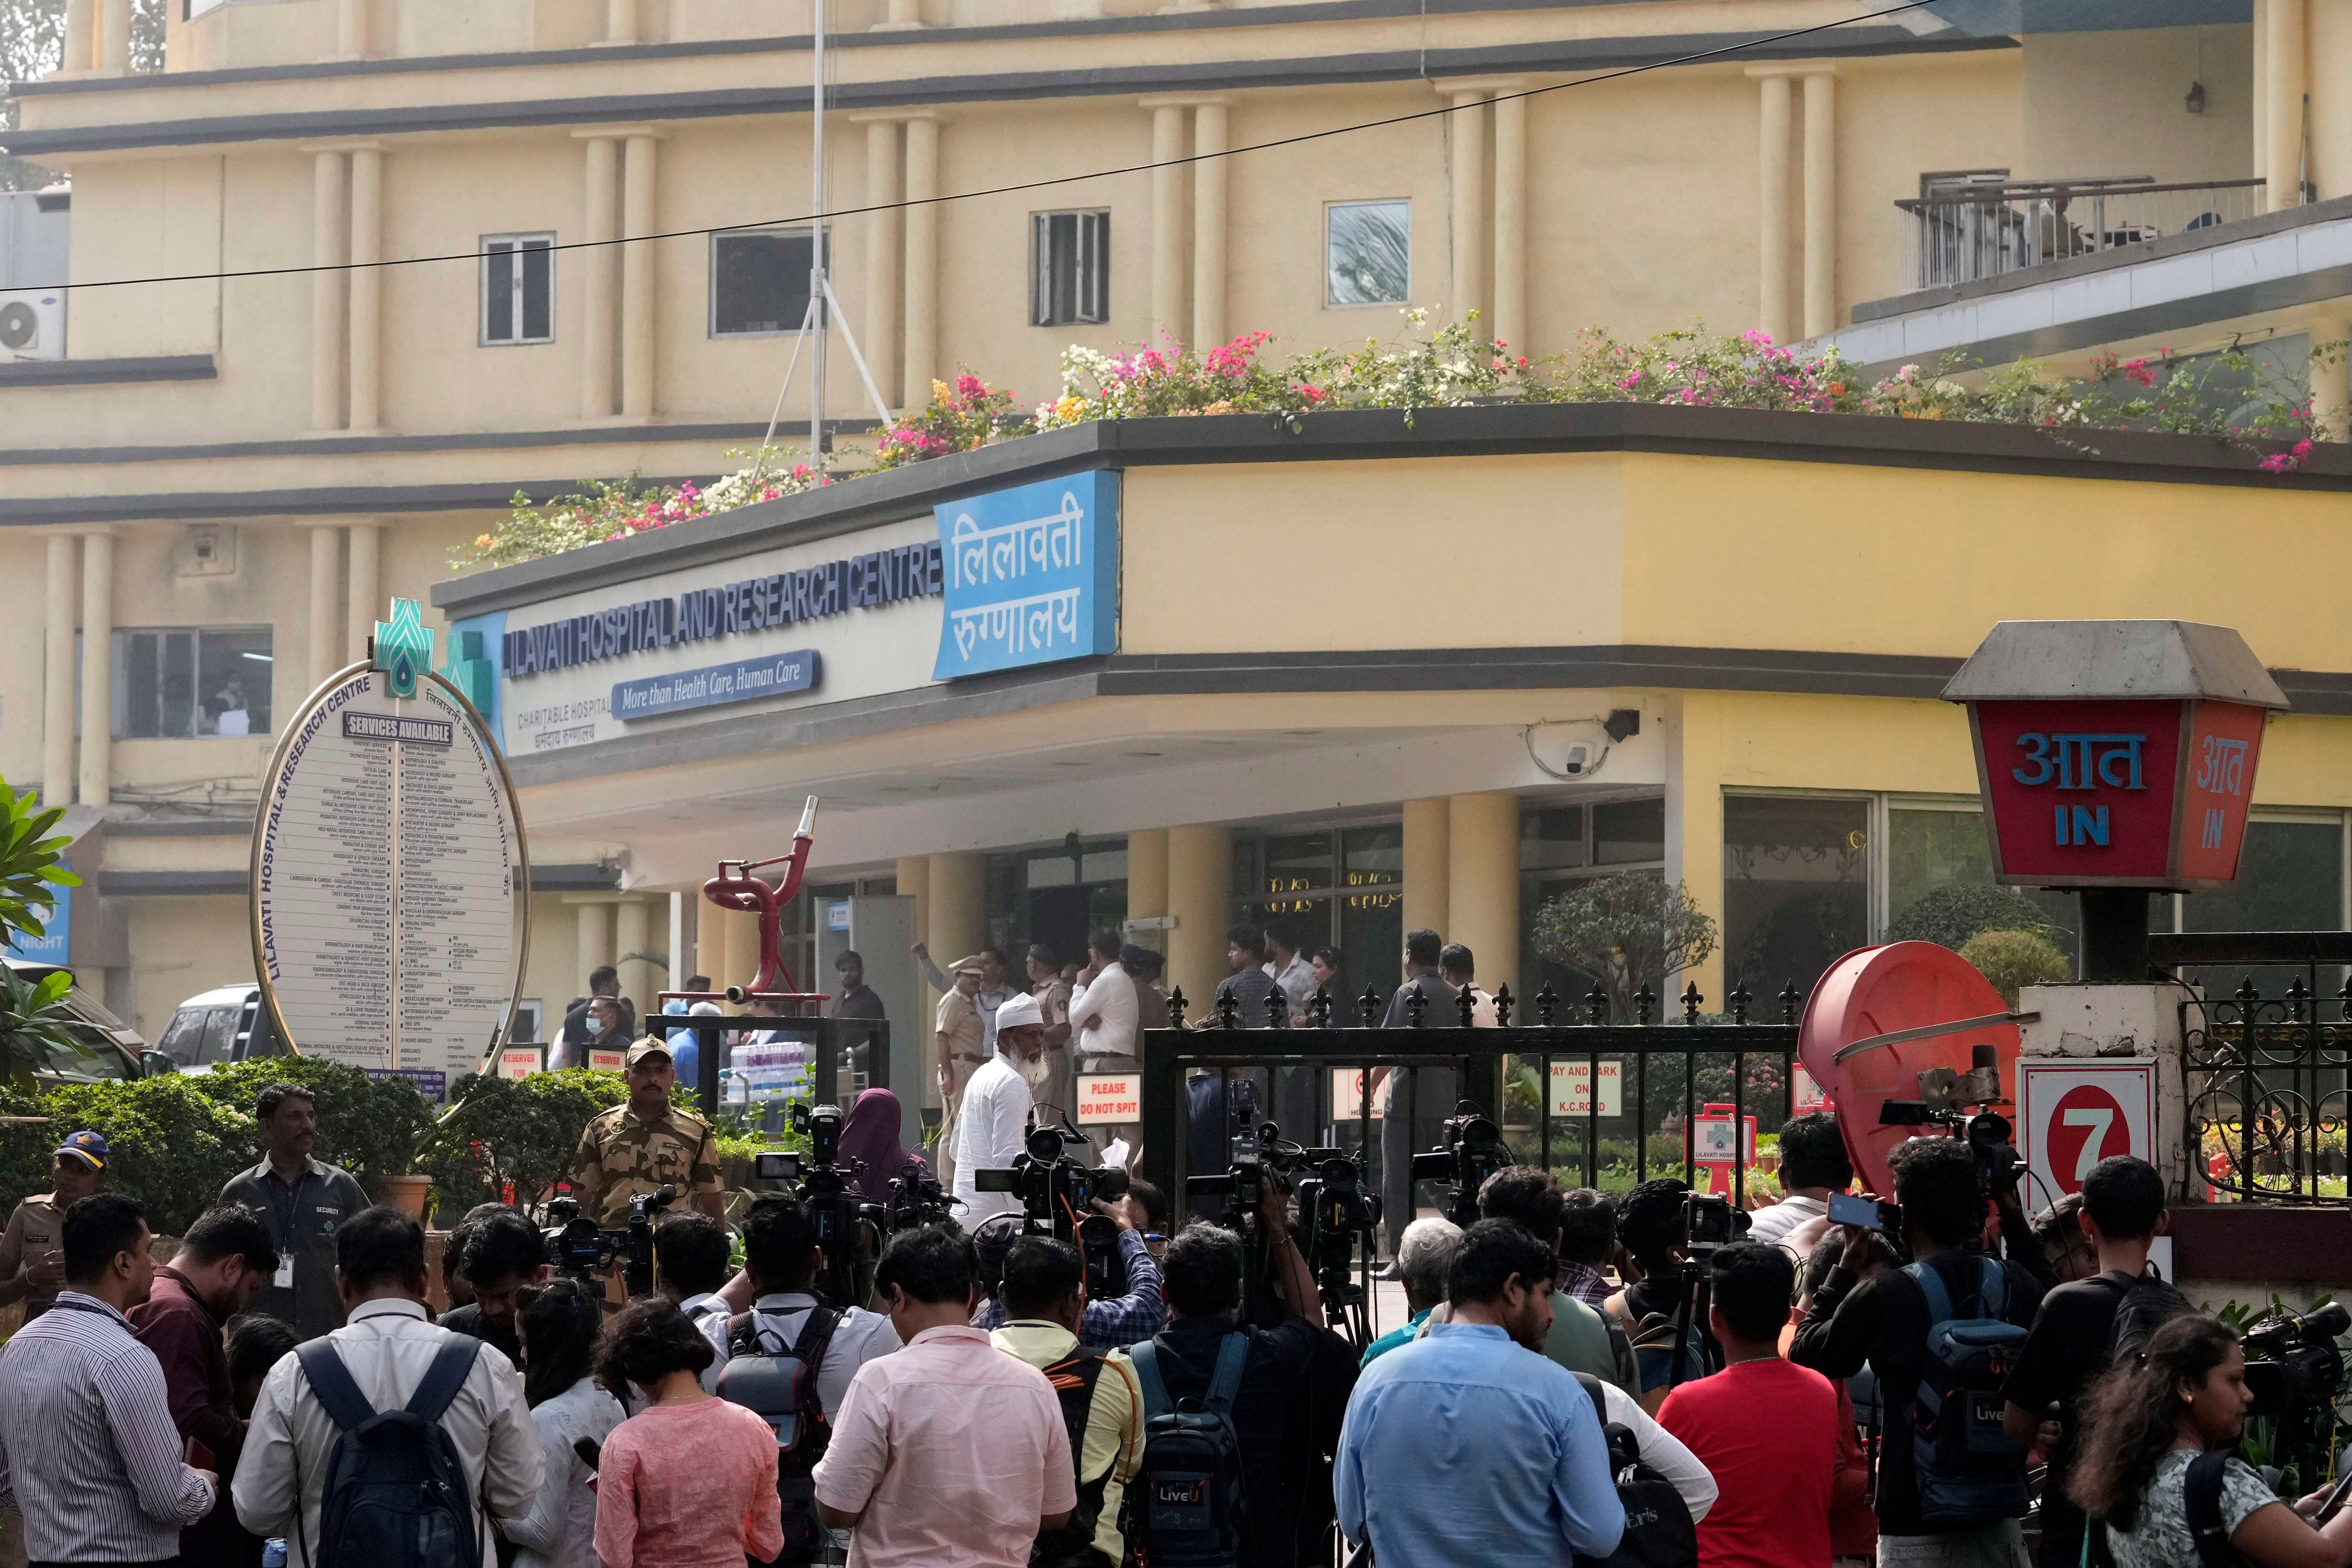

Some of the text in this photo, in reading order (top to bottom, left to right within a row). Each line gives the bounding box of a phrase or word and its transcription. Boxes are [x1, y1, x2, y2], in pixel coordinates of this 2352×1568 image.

[951, 491, 1084, 589] लिलावती
[503, 540, 944, 678] LILAVATI HOSPITAL AND RESEARCH CENTRE
[951, 588, 1081, 661] रुग्णालय
[622, 661, 800, 709] More than Health Care, Human Care
[349, 715, 449, 742] SERVICES AVAILABLE
[518, 697, 611, 730] CHARITABLE HOSPITAL
[426, 688, 461, 724] लिलावती
[463, 722, 487, 772] रुग्णालय
[486, 775, 499, 809] आणि
[562, 724, 595, 745] रुग्णालय
[2013, 732, 2148, 790] आत
[2198, 735, 2248, 795] आत
[260, 676, 370, 980] LILAVATI HOSPITAL & RESEARCH CENTRE
[2055, 805, 2109, 846] IN
[2202, 808, 2224, 849] IN
[20, 935, 64, 949] NIGHT
[503, 1054, 535, 1063] RESERVED
[513, 1069, 525, 1078] FOR
[593, 1055, 620, 1065] RESERVED
[1568, 1067, 1588, 1076] AND
[1598, 1067, 1617, 1076] ARK
[1092, 1083, 1125, 1094] PLEASE
[1575, 1085, 1589, 1094] ON
[1081, 1102, 1137, 1114] DO NOT SPIT
[1559, 1102, 1606, 1111] K.C.ROD
[2063, 1108, 2113, 1181] 7
[316, 1207, 339, 1215] SECURITY
